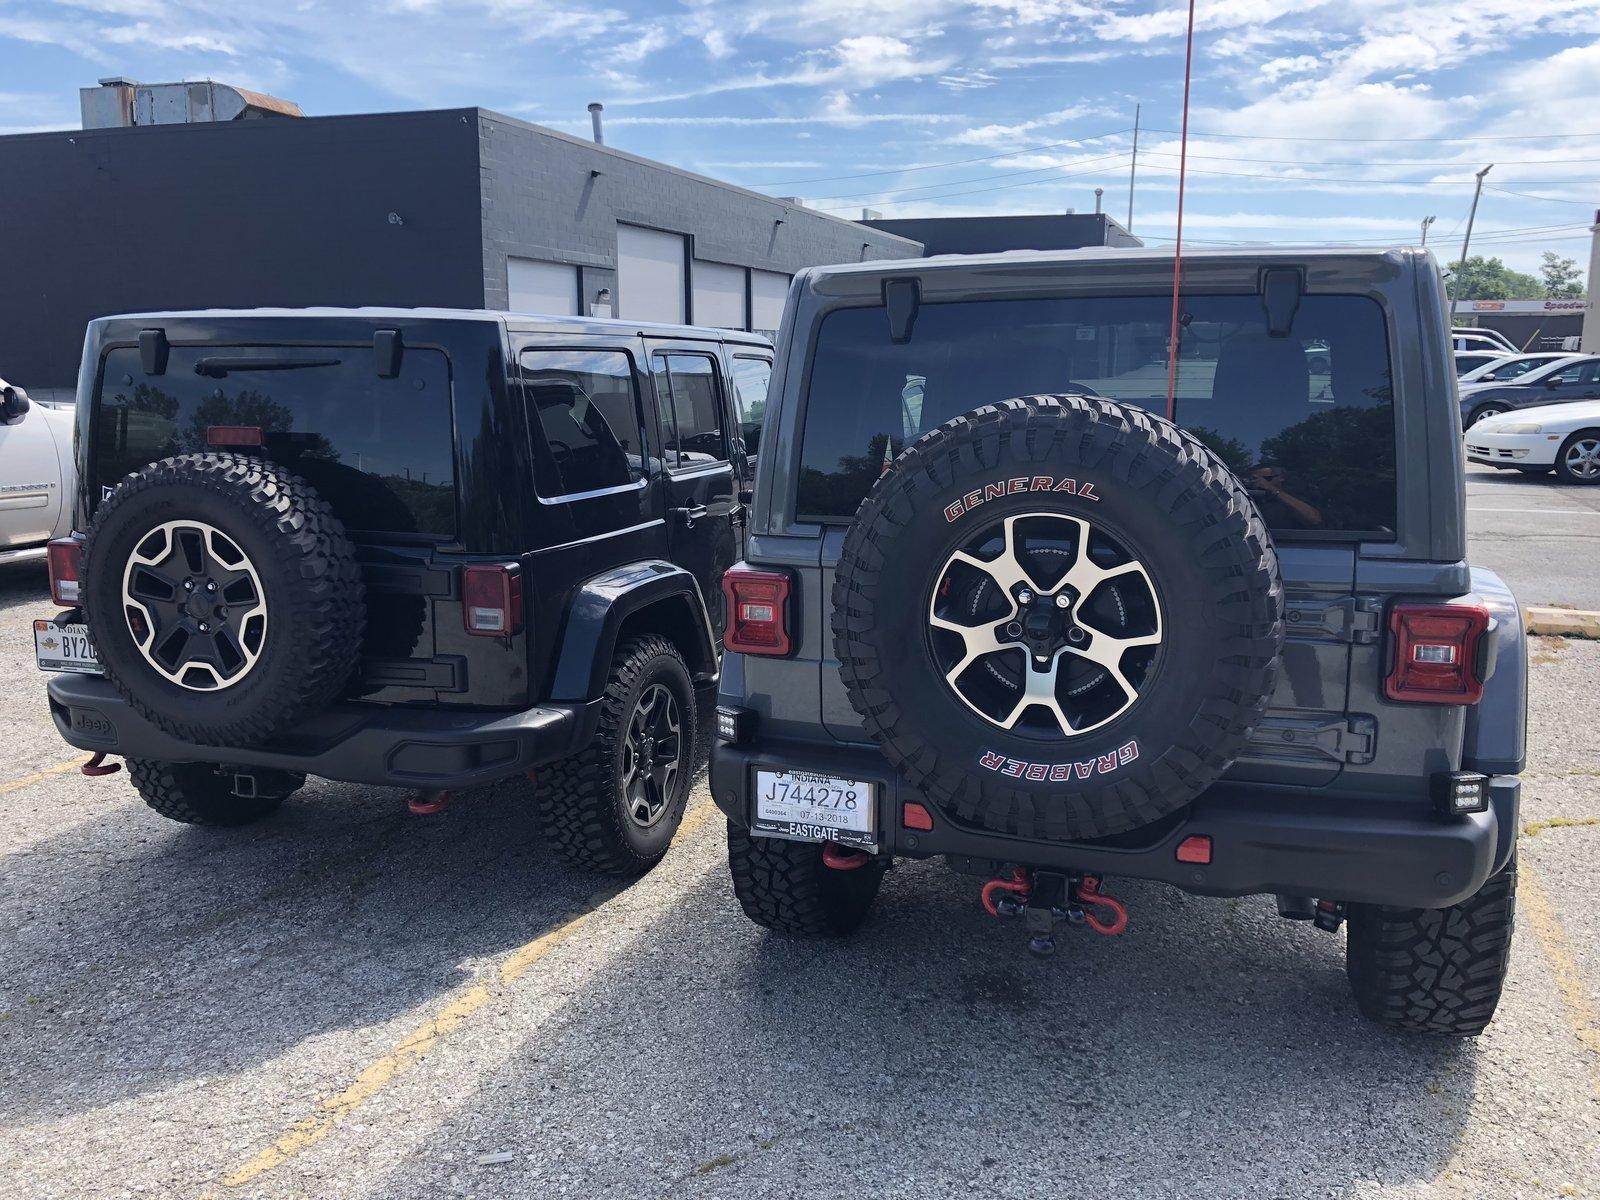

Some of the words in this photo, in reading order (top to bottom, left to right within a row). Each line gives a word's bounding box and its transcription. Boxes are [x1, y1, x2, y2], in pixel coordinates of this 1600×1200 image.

[944, 476, 1100, 523] GENERAL
[78, 715, 111, 735] Jeep
[979, 740, 1139, 782] GRABBER
[791, 774, 831, 785] INDIANA
[765, 782, 857, 810] J744278
[800, 810, 849, 824] 07-13-2018
[789, 822, 839, 841] EASTGATE
